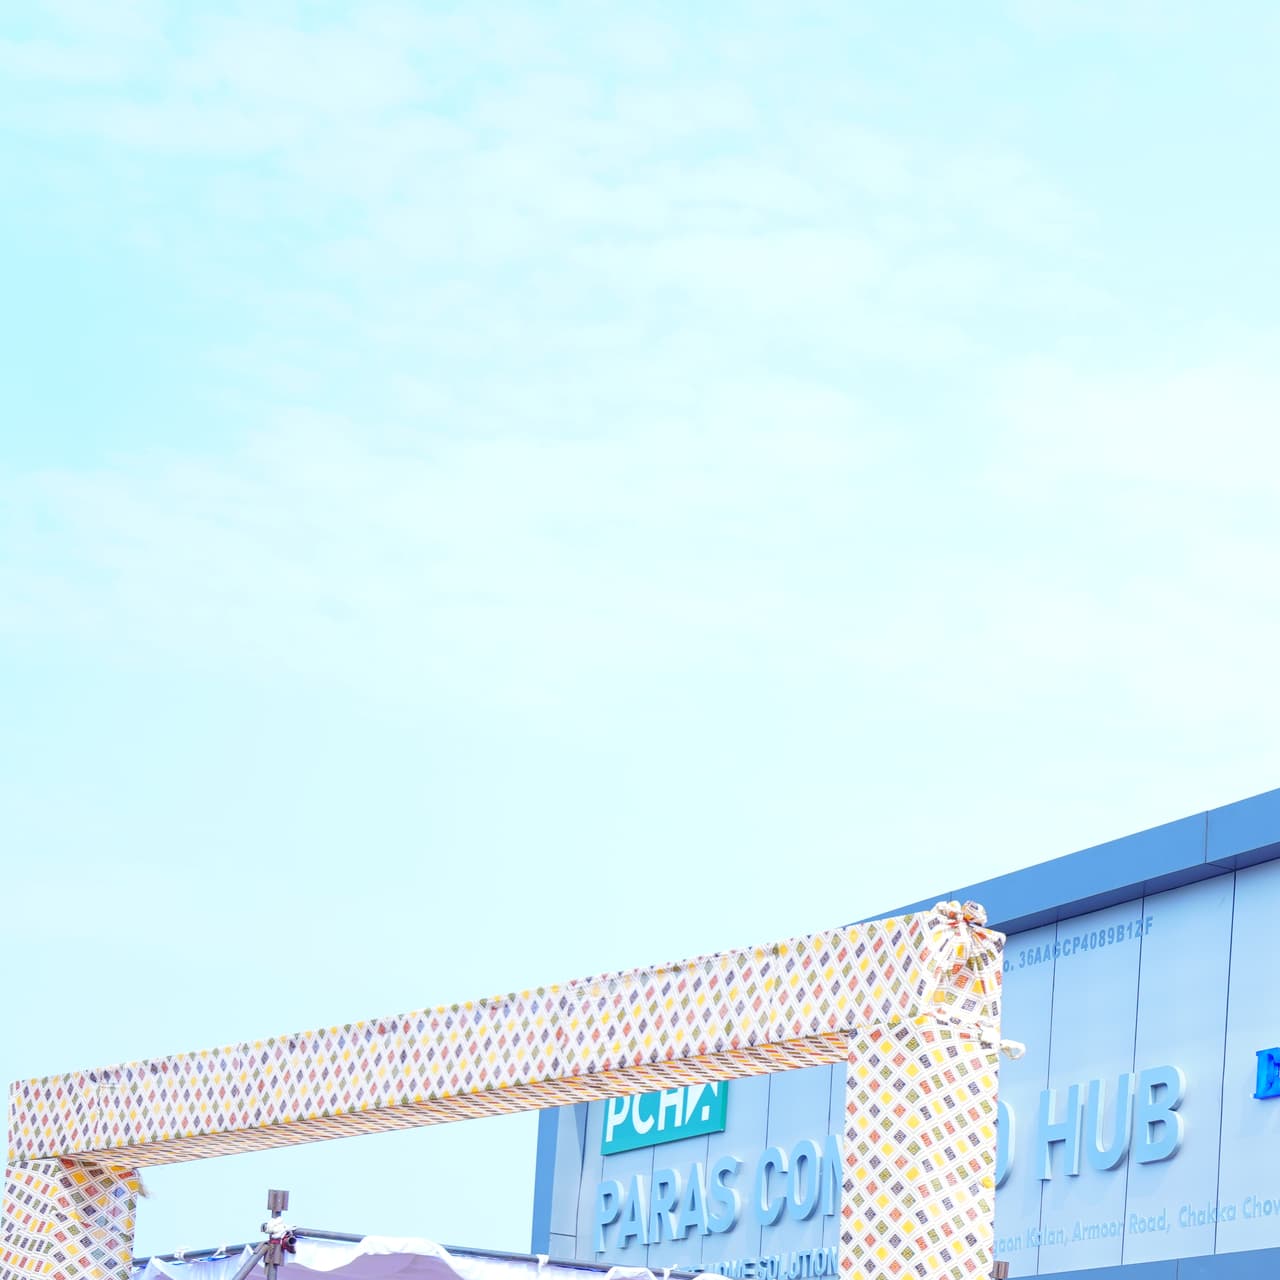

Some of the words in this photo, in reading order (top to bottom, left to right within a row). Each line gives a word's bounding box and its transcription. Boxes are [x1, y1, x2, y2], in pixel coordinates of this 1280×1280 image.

[592, 1155, 745, 1254] PARAS
[1036, 1064, 1188, 1182] HUB
[1128, 1208, 1170, 1234] Road,
